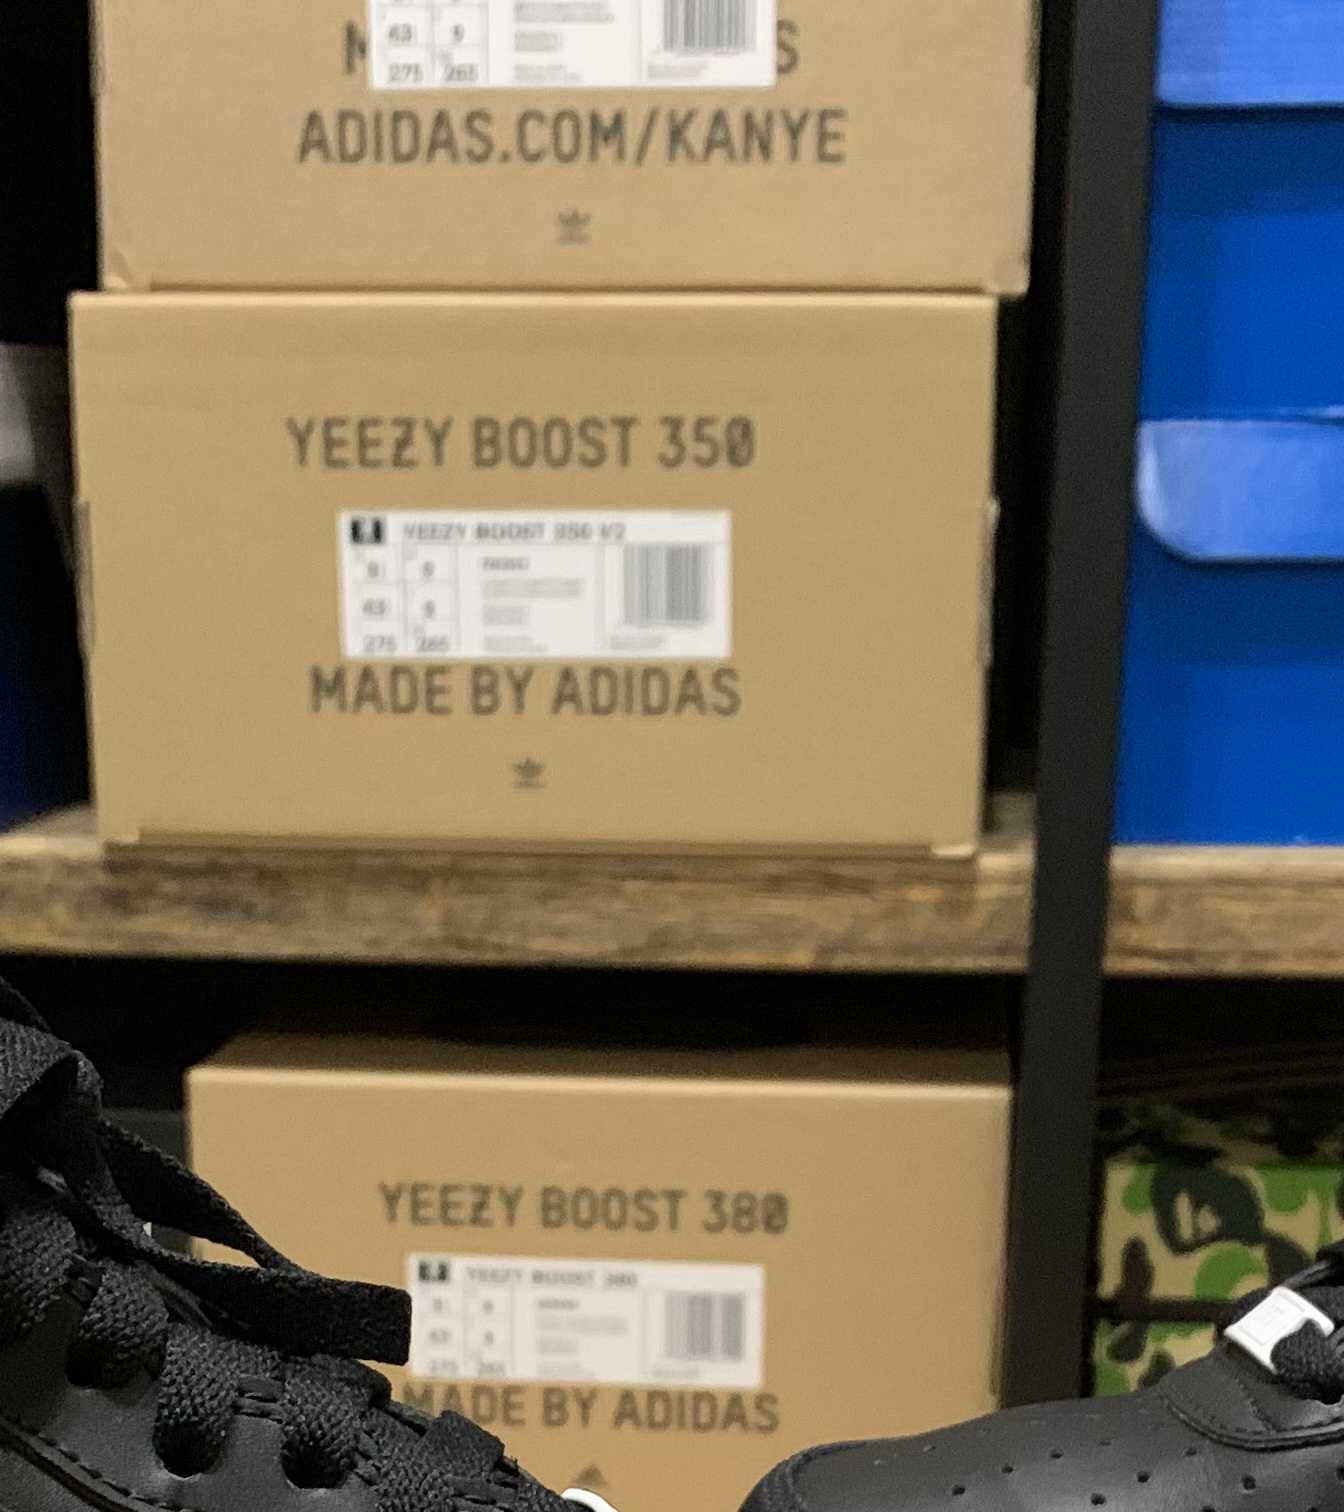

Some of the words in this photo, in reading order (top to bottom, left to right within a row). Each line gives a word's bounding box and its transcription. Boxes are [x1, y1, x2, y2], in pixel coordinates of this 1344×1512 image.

[299, 107, 848, 165] ADIDAS.COM/KANYE
[286, 416, 453, 469] YEEZY
[472, 416, 640, 469] BOOST
[657, 415, 755, 469] 350
[405, 522, 466, 541] YEEZY
[475, 522, 545, 541] BOOST
[309, 664, 452, 717] MADE
[470, 665, 534, 717] BY
[551, 666, 742, 718] ADIDAS
[379, 1181, 523, 1228] YEEZY
[540, 1185, 687, 1232] BOOST
[702, 1190, 789, 1235] 380
[402, 1384, 526, 1427] MADE
[542, 1386, 600, 1429] BY
[613, 1388, 780, 1434] ADIDAS
